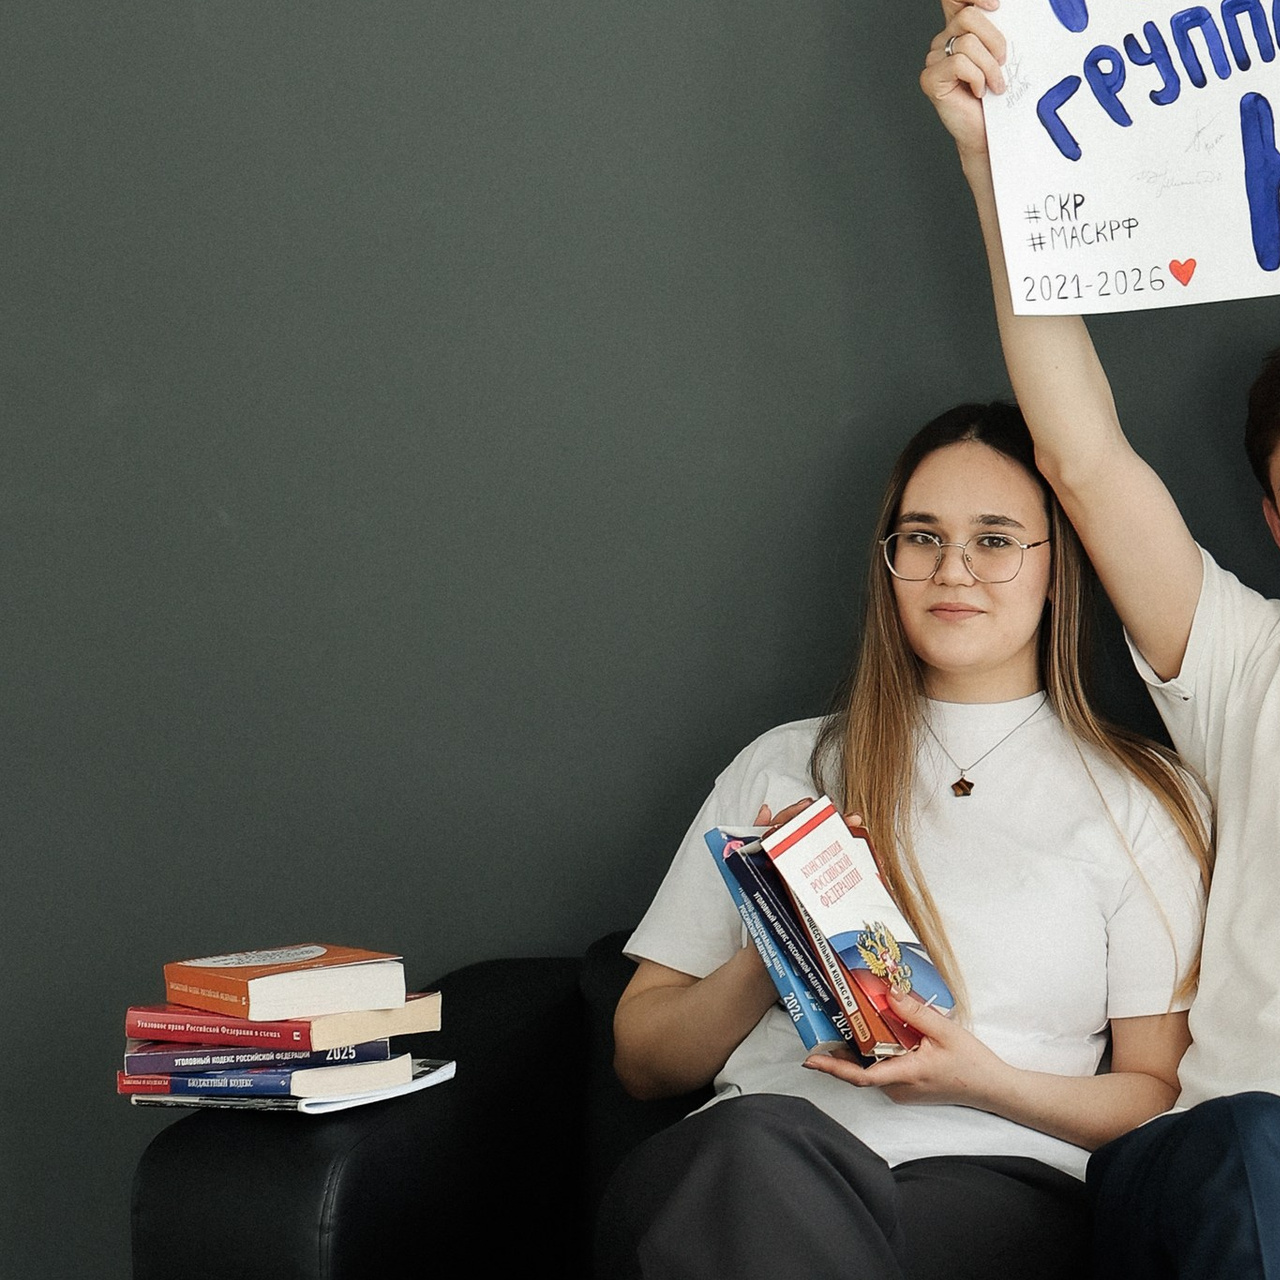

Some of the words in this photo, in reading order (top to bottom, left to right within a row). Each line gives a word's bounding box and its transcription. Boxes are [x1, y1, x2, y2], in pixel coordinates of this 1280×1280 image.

[1024, 193, 1085, 223] #СКР
[1026, 217, 1139, 252] #МАСКРФ
[1023, 265, 1165, 302] 2021-2026
[800, 840, 844, 878] КОНСТИТУЦИЯ
[810, 853, 853, 894] РОССИЙСКОЙ
[820, 867, 863, 908] ФЕДЕРАЦИИ
[738, 904, 759, 938] РОССИЙСКОЙ
[754, 935, 773, 969] ФЕДЕРАЦИИ
[753, 890, 777, 923] УГОЛОВНЫЙ
[773, 920, 790, 943] КОДЕКС
[786, 940, 812, 974] РОССИЙСКОЙ
[808, 972, 830, 1003] ФЕДЕРАЦИИ
[771, 955, 786, 979] КОДЕКС
[831, 967, 847, 996] КОДЕКС
[844, 995, 853, 1008] РФ
[783, 991, 804, 1023] 2026
[136, 1020, 166, 1032] Уголовное
[168, 1023, 185, 1032] право
[186, 1024, 220, 1034] Российской
[221, 1026, 254, 1037] Федерации
[832, 1011, 854, 1041] 2025
[174, 1055, 211, 1067] УГОЛОВНЫЙ
[212, 1054, 235, 1065] КОДЕКС
[235, 1051, 275, 1063] РОССИЙСКОЙ
[275, 1050, 311, 1060] ФЕДЕРАЦИИ
[326, 1046, 356, 1061] 2025
[187, 1077, 229, 1088] БЮДЖЕТНЫЙ
[229, 1078, 254, 1088] КОДЕКС
